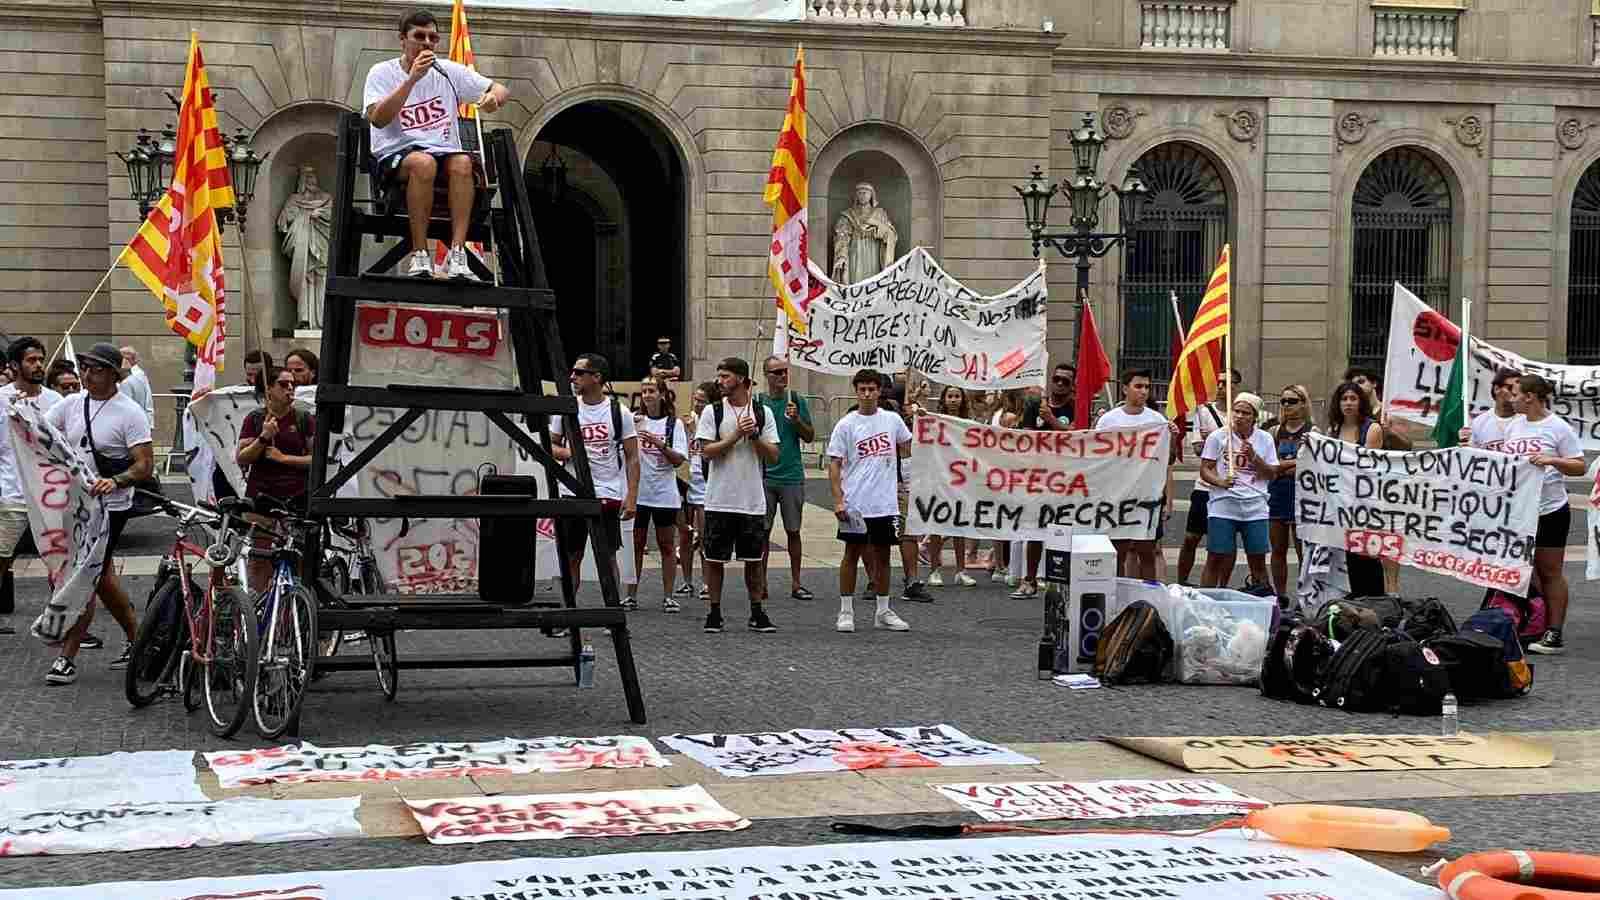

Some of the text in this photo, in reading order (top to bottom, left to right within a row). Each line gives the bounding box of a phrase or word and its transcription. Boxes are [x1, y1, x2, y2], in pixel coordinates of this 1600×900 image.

[401, 100, 446, 127] SOS
[369, 309, 491, 350] STOP
[832, 313, 910, 344] PLATGES
[934, 325, 956, 348] UN
[950, 352, 988, 382] JA!
[582, 424, 609, 441] OS
[858, 435, 891, 456] SOS
[917, 418, 950, 447] EL
[1306, 438, 1391, 474] VOLEM
[1505, 439, 1542, 456] SOS
[1299, 468, 1341, 495] QUE
[915, 495, 1163, 532] VOLEM DECRET
[1299, 498, 1537, 566] EL NOSTRE SECTOR
[1348, 530, 1402, 560] SOS
[943, 784, 1087, 798] VOLEM
[416, 799, 627, 817] VOLEM
[493, 845, 1220, 888] VOLEM UNA LLEI QUE REGULI LA
[756, 875, 785, 887] A
[799, 870, 882, 884] LES
[890, 863, 1098, 880] NOSTRES
[1108, 854, 1299, 871] PLATGES
[969, 879, 1067, 892] QUE
[1072, 867, 1333, 887] DIGNIFIQUI
